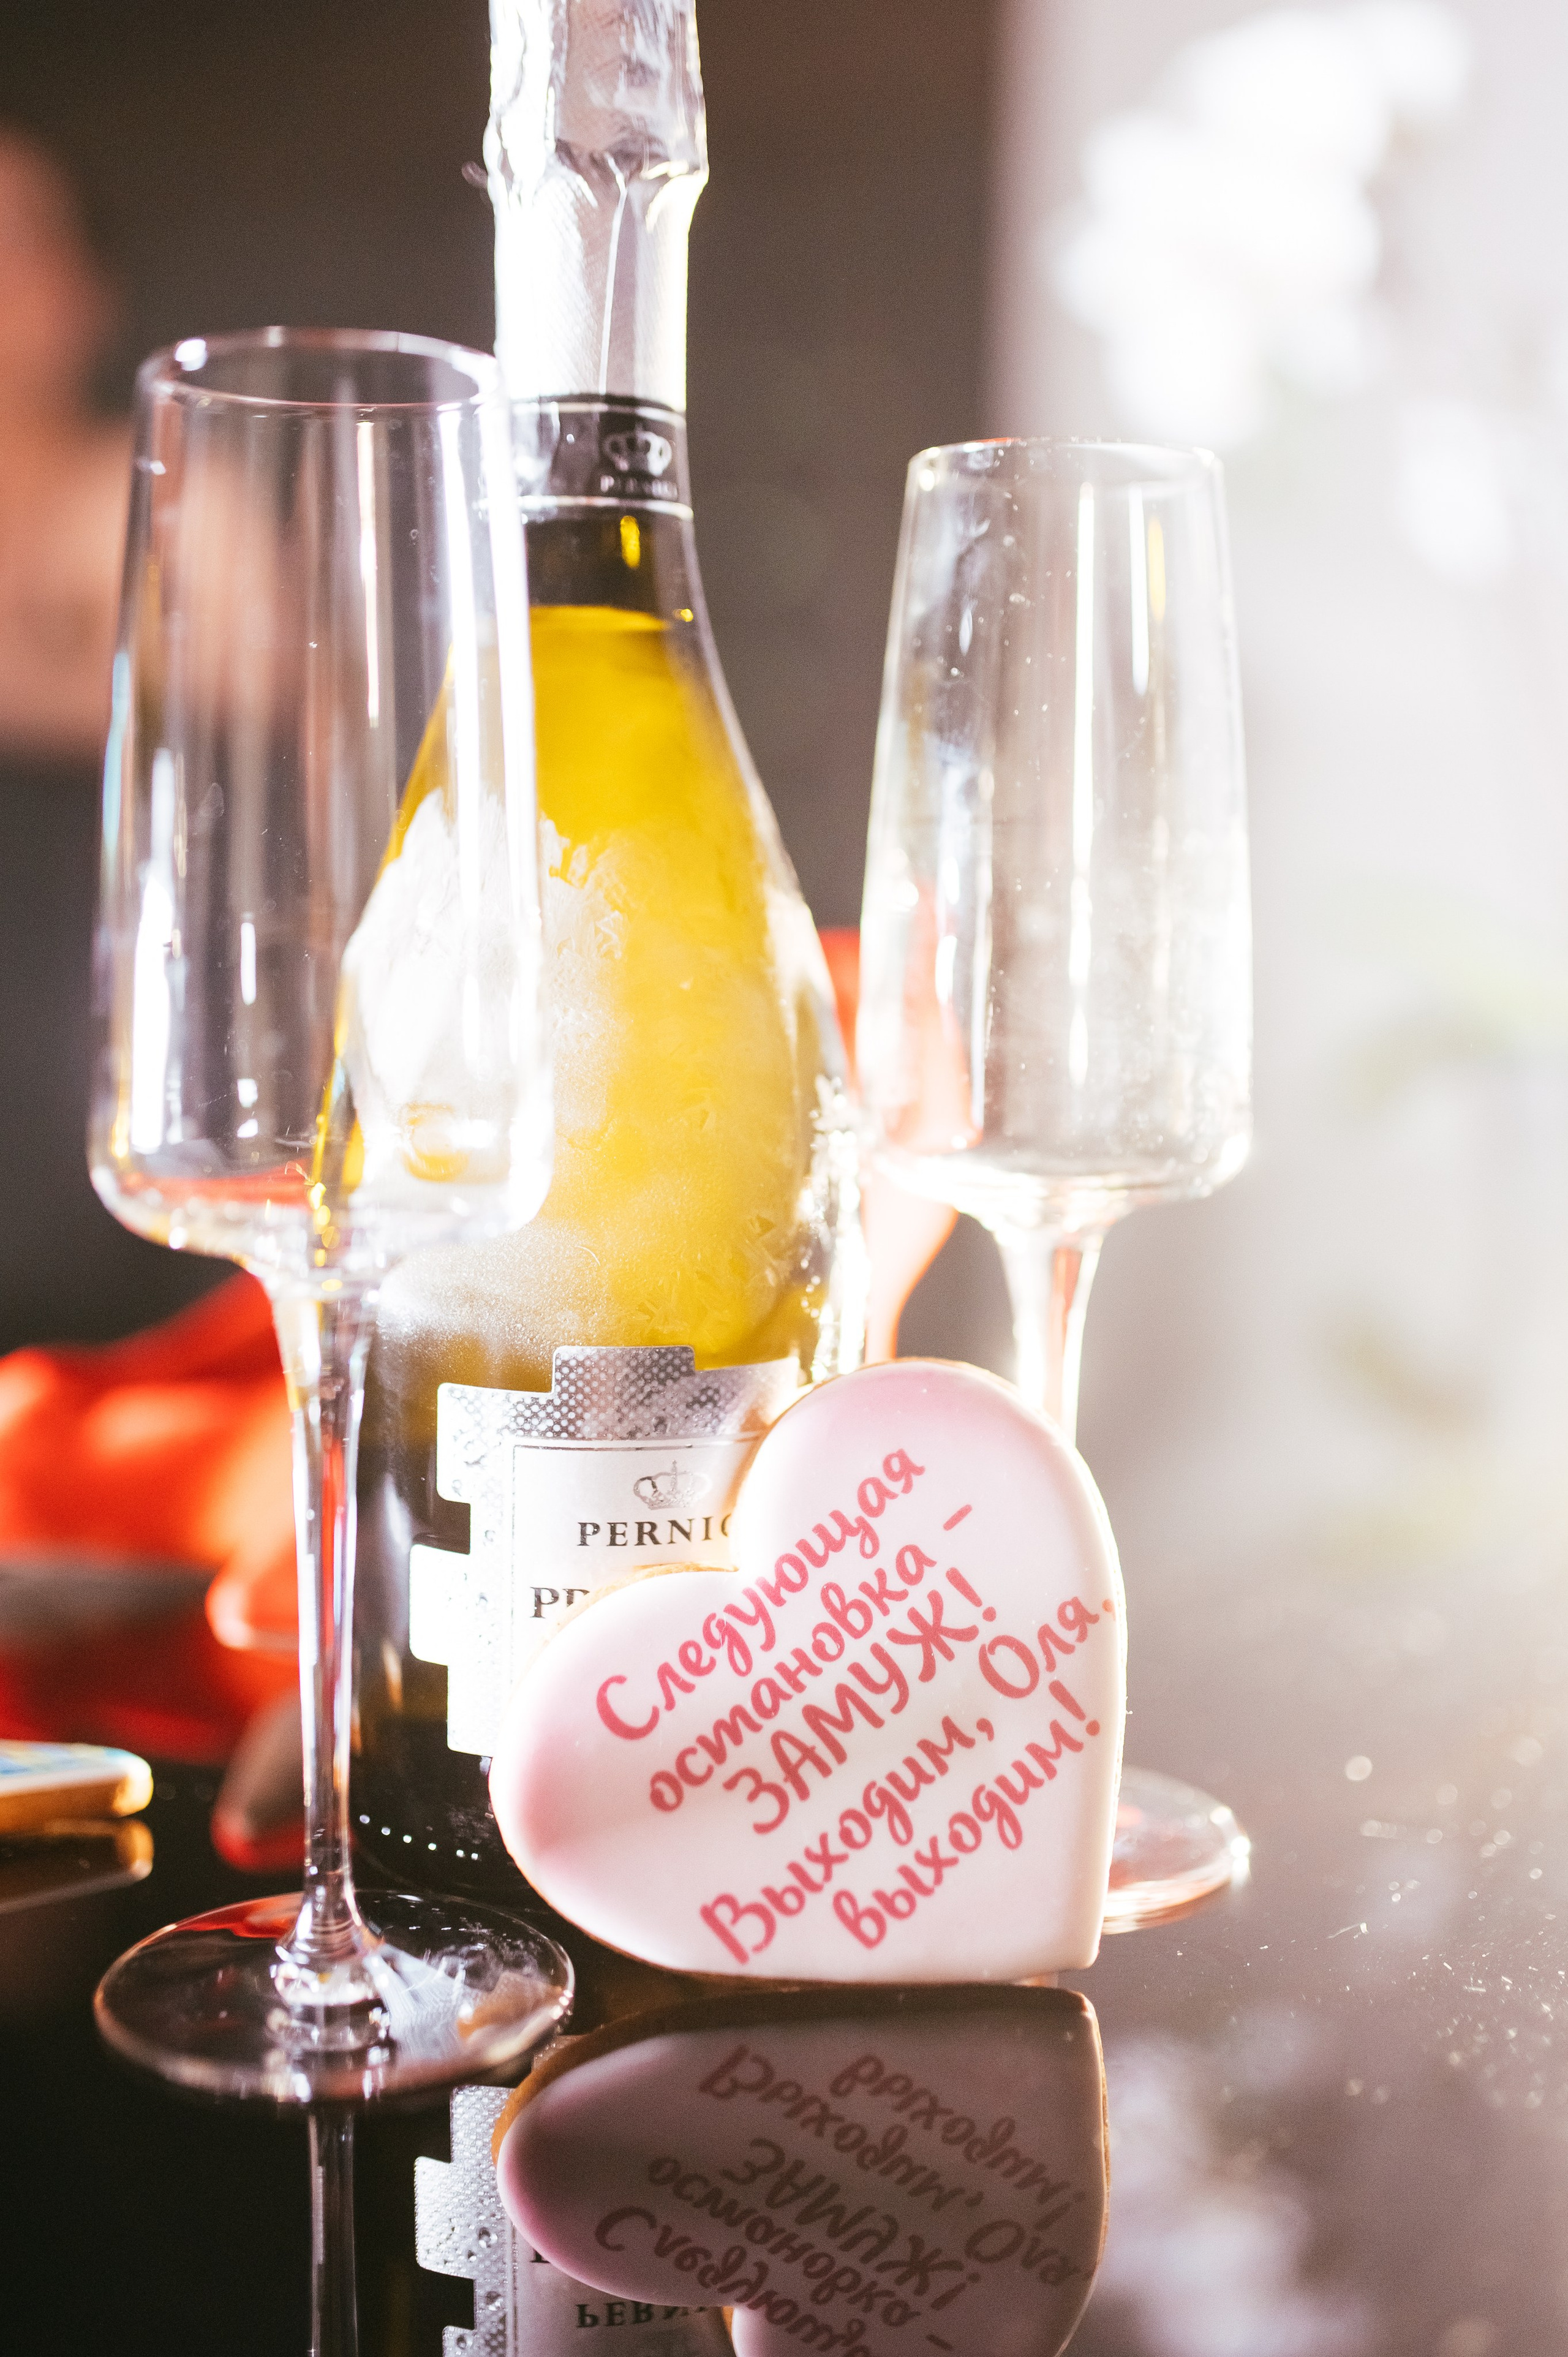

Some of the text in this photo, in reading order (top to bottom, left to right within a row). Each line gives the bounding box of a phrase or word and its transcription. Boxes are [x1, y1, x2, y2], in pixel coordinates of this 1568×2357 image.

[595, 1448, 925, 1741] Следующая
[649, 1543, 937, 1812] остановка
[722, 1566, 997, 1835] ЗАМУЖ!
[699, 1715, 996, 1965] Выходим,
[832, 1680, 1101, 1950] выходим!
